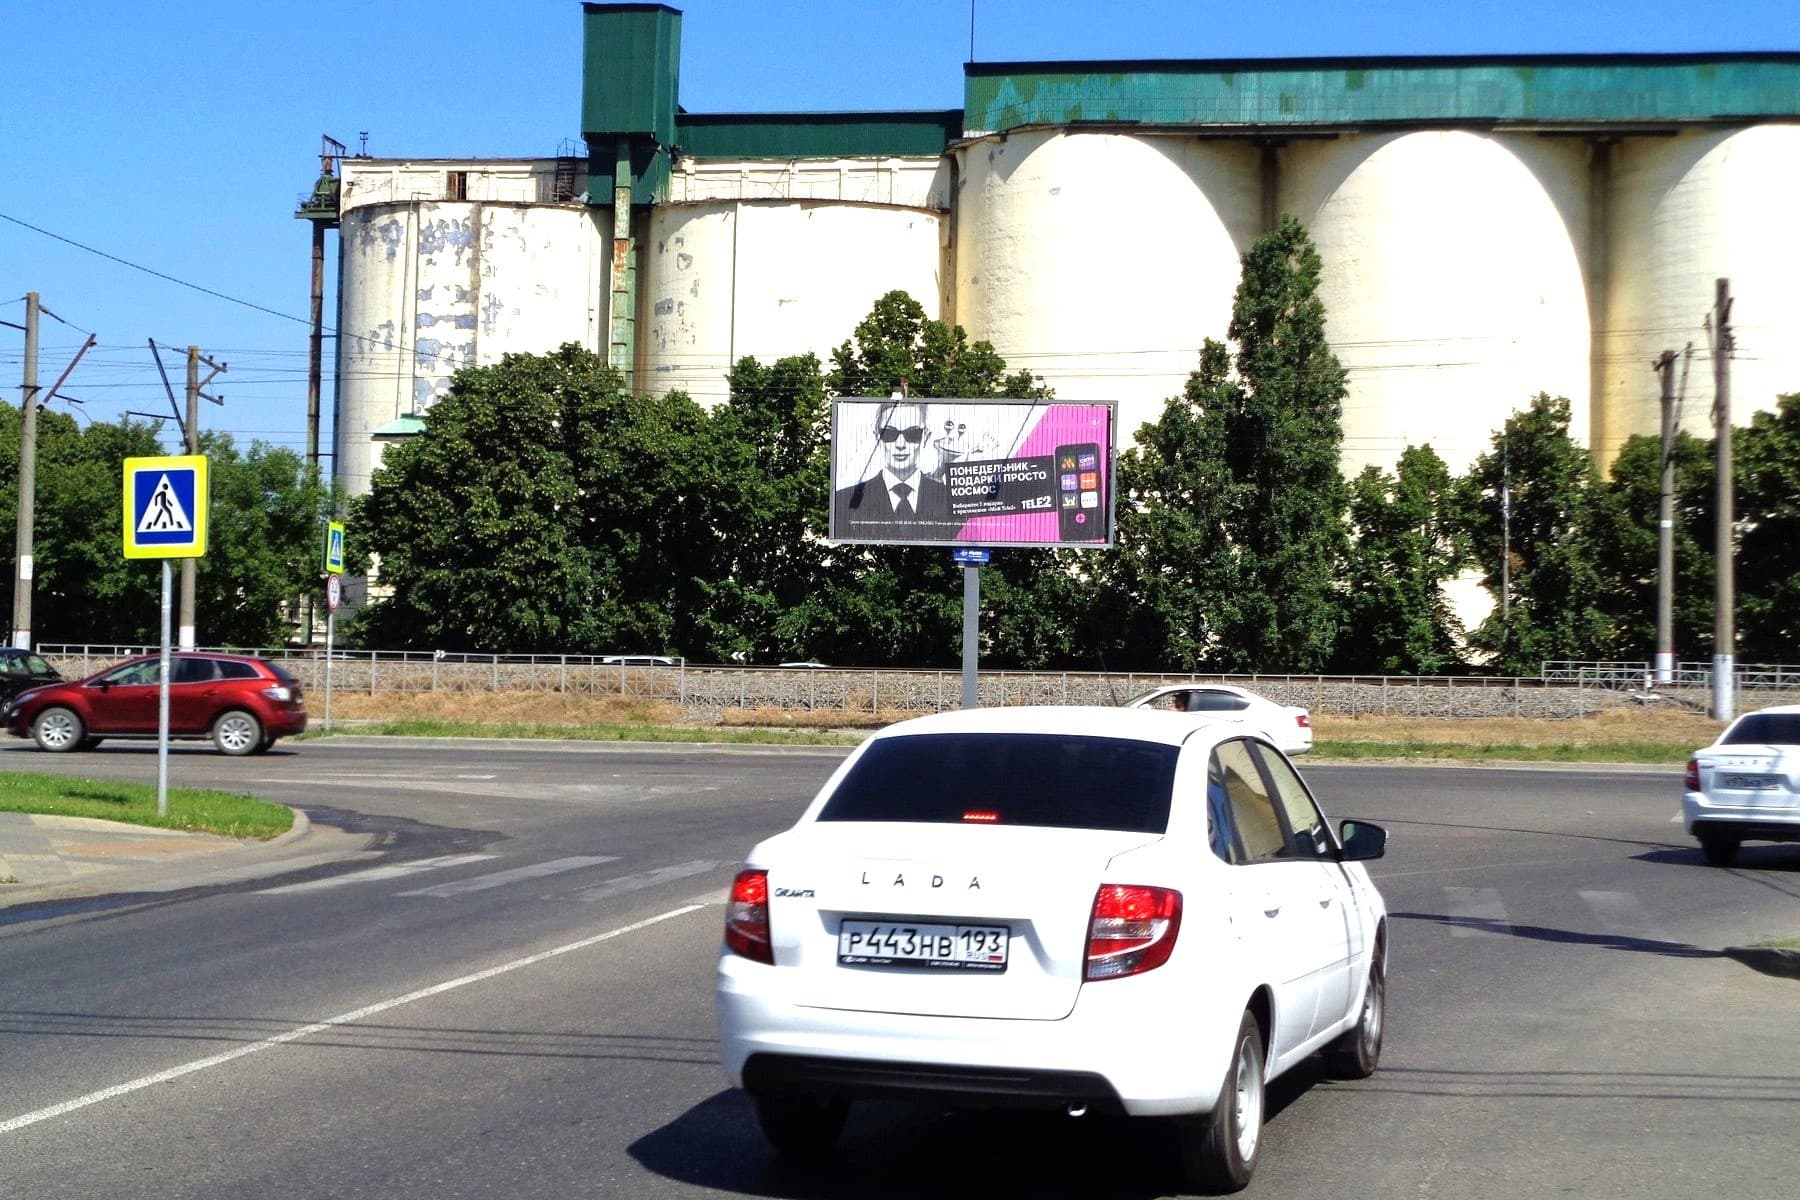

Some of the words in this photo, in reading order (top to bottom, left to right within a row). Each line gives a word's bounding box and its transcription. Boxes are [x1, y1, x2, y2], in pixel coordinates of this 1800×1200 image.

[949, 462, 1028, 476] ПОНЕДЕЛЬНИК
[950, 474, 1001, 486] ПОДАРКИ
[1003, 471, 1046, 483] ПРОСТО
[951, 485, 996, 496] КОСМОС
[1021, 495, 1052, 510] TELE2
[861, 871, 981, 889] LADA
[960, 929, 1001, 952] 193
